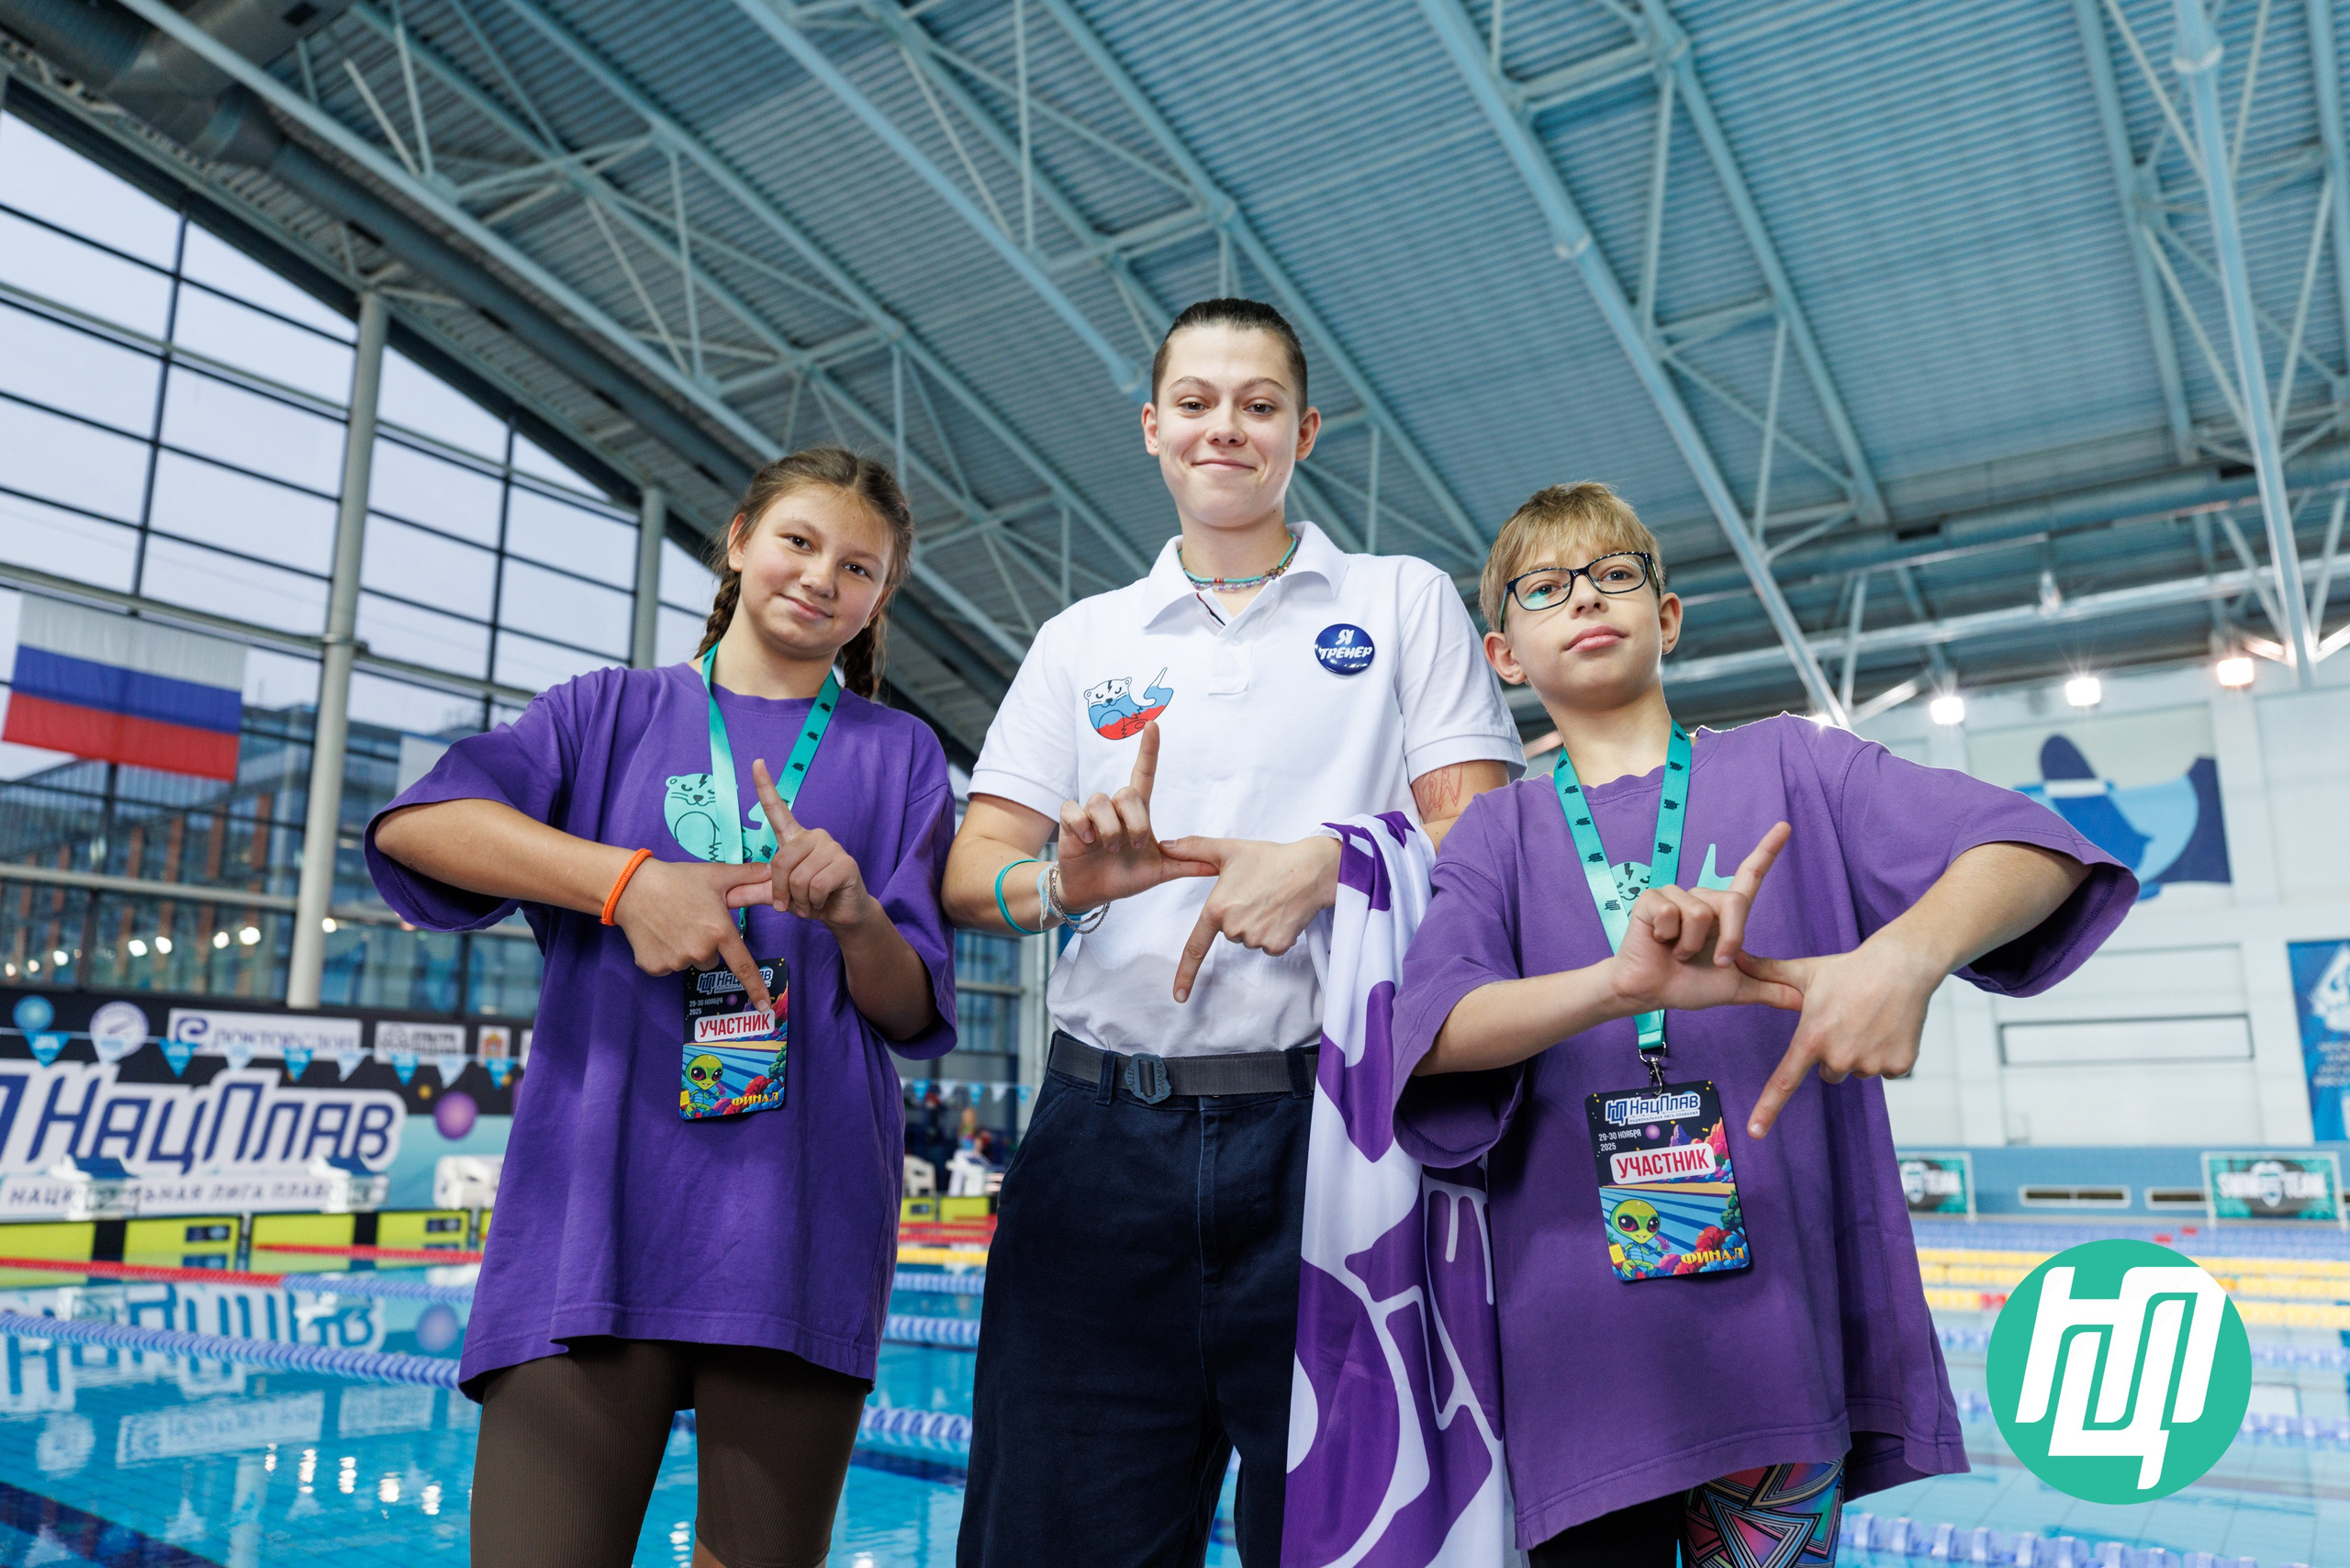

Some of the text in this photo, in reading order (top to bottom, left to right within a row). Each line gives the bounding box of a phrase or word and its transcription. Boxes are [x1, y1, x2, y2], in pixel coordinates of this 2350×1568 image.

[1335, 629, 1355, 645] Я
[1320, 646, 1373, 660] ТРЕНЕР
[704, 997, 723, 1006] НОЯБРЯ
[699, 1013, 771, 1038] УЧАСТНИК
[732, 1092, 779, 1106] ФИНАЛ
[1598, 1129, 1642, 1141] 29-30 НОЯБРЯ
[1600, 1142, 1617, 1152] 2025
[1617, 1148, 1710, 1179] УЧАСТНИК
[1680, 1247, 1744, 1265] ФИНАЛ
